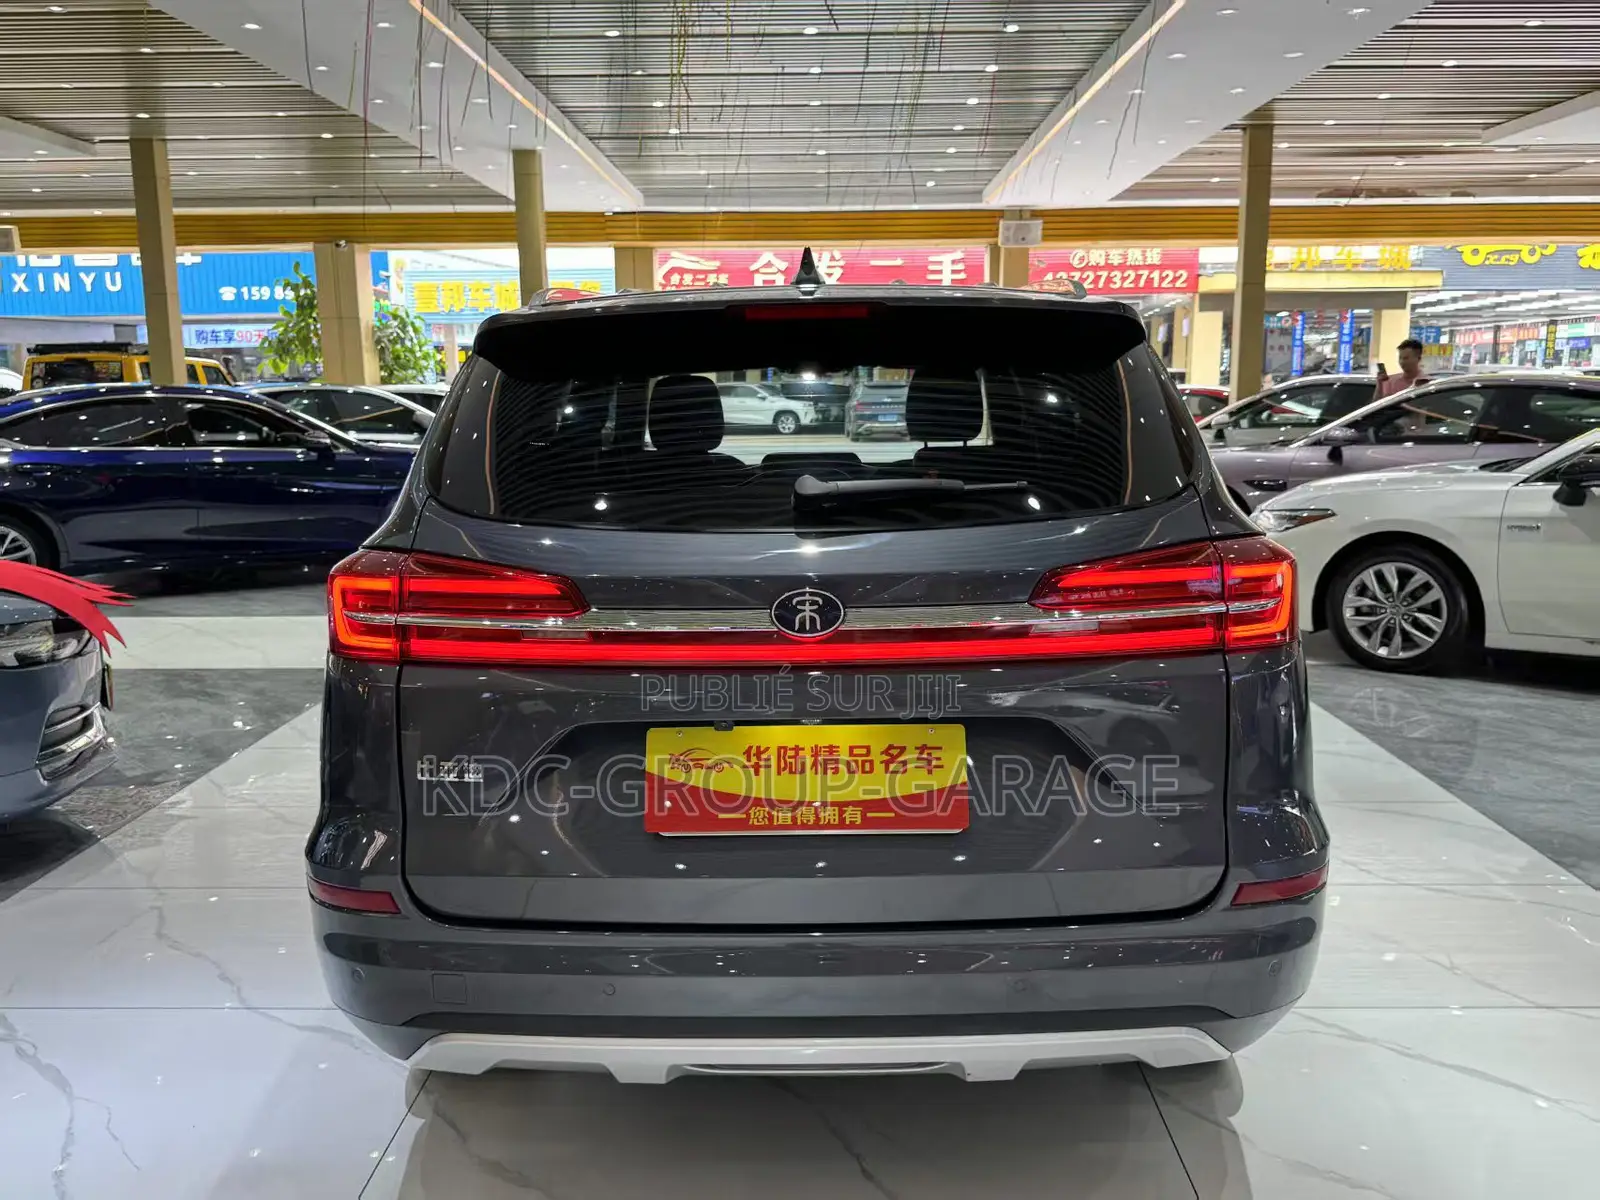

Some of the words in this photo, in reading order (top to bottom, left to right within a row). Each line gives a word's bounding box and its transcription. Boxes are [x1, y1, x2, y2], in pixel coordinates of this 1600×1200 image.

[1089, 249, 1163, 266] 购车热线
[11, 271, 122, 293] XINYU
[240, 286, 271, 300] 159
[742, 744, 944, 777] 华陆精品名车
